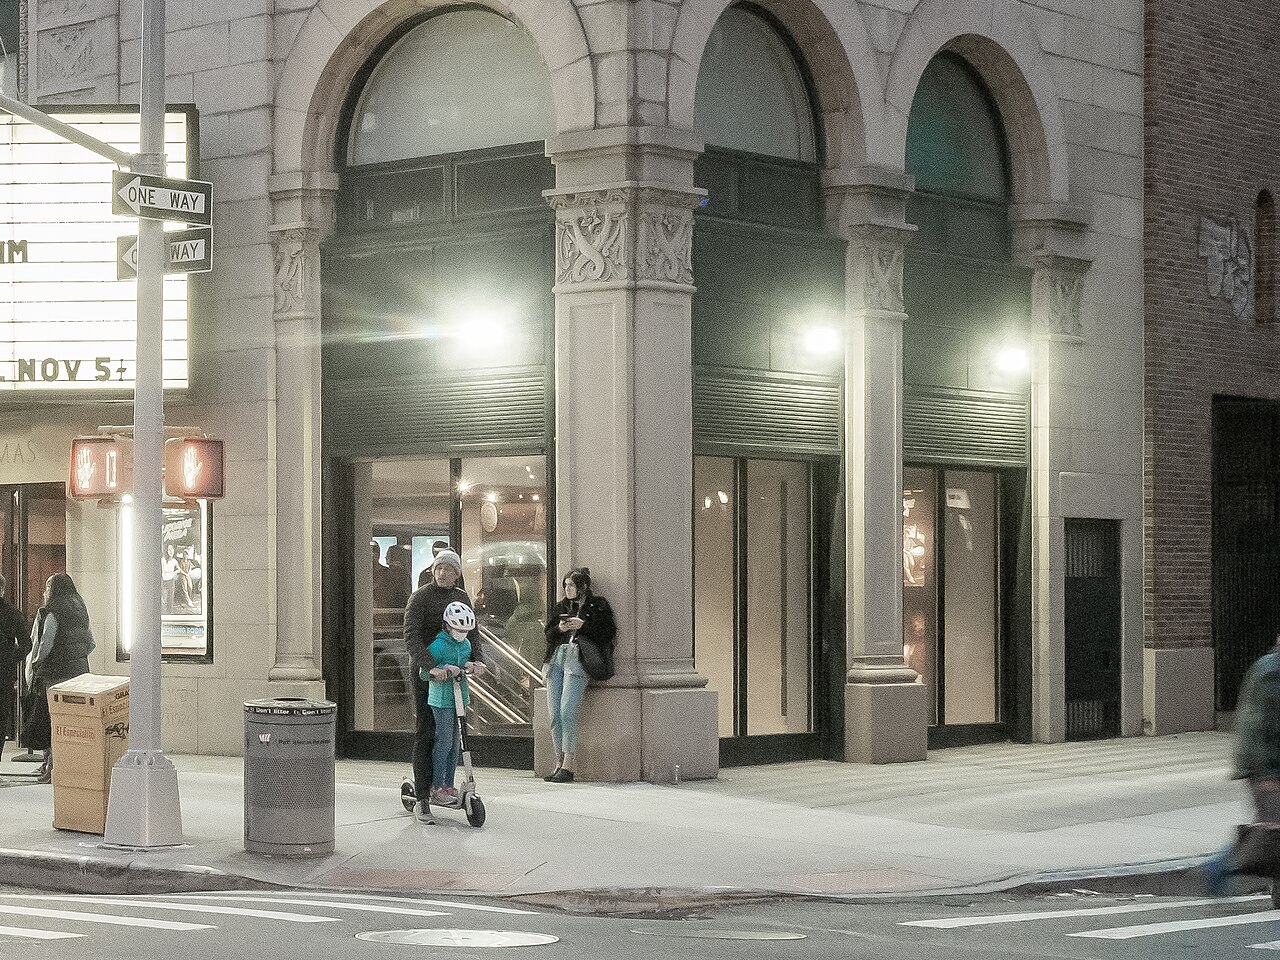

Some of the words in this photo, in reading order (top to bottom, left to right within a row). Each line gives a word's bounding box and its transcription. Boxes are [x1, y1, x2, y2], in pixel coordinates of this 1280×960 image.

[128, 187, 156, 205] ONE
[170, 192, 199, 211] WAY
[170, 242, 199, 260] WAY
[18, 357, 82, 382] NOV
